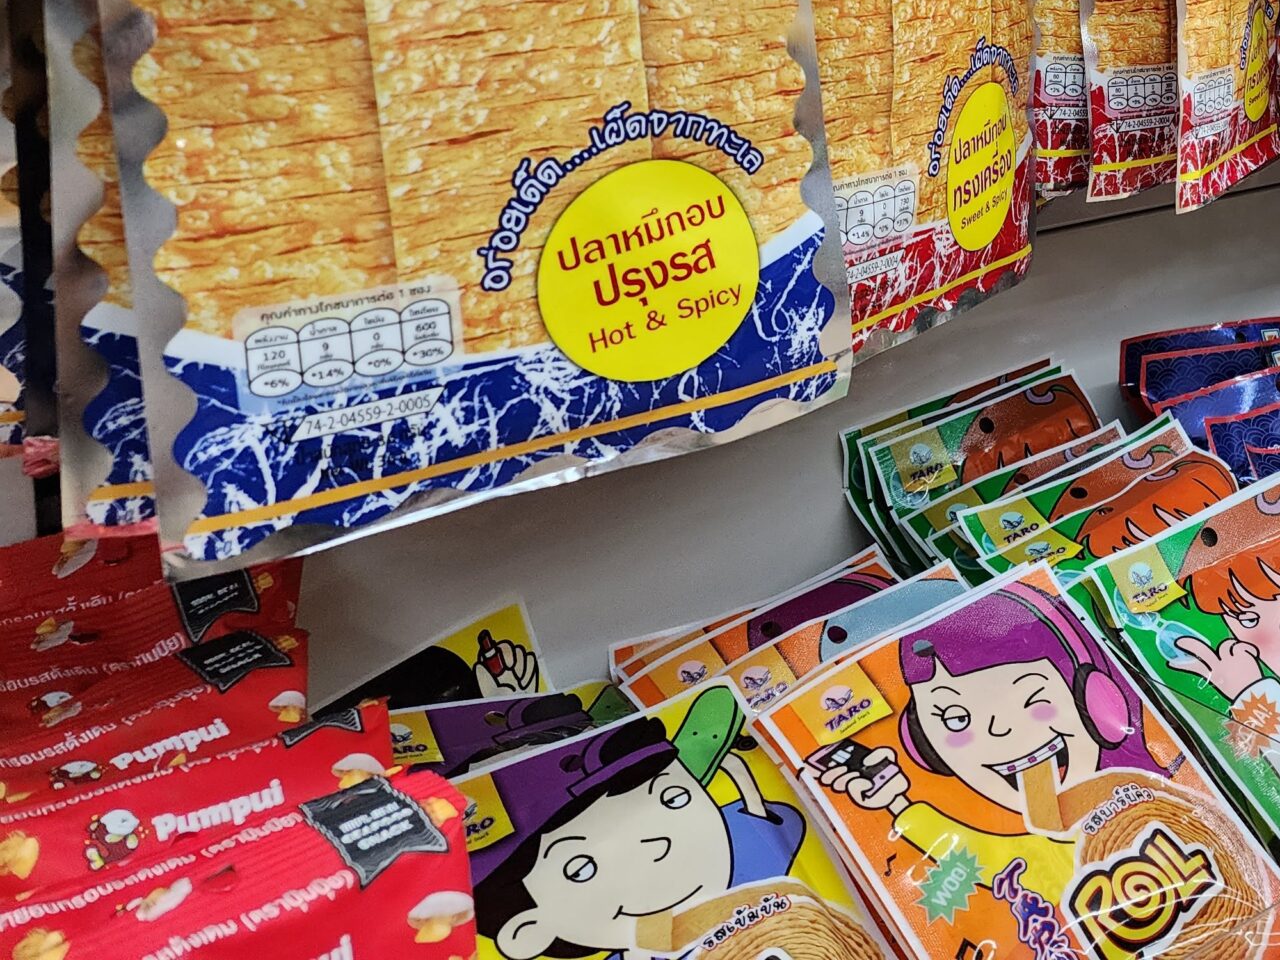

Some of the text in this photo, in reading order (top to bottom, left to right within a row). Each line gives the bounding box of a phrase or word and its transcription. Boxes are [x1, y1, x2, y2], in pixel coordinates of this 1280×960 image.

[951, 146, 1014, 211] ทรงเครื่อง
[557, 194, 727, 272] ปลาหมึกอบ
[960, 210, 985, 231] Sweet
[592, 237, 718, 308] ปรุงรส
[587, 283, 743, 354] Hot & Spicy
[262, 349, 286, 362] 120
[321, 341, 330, 353] 9
[372, 331, 381, 342] 0
[305, 393, 432, 436] 74-2-04559-2-0005
[909, 463, 944, 482] TARO
[1003, 522, 1040, 545] TARO
[823, 698, 873, 732] TARO
[108, 717, 231, 771] Pumpui
[151, 778, 285, 842] Pumpui
[465, 815, 495, 837] RO
[928, 860, 973, 909] WOO!
